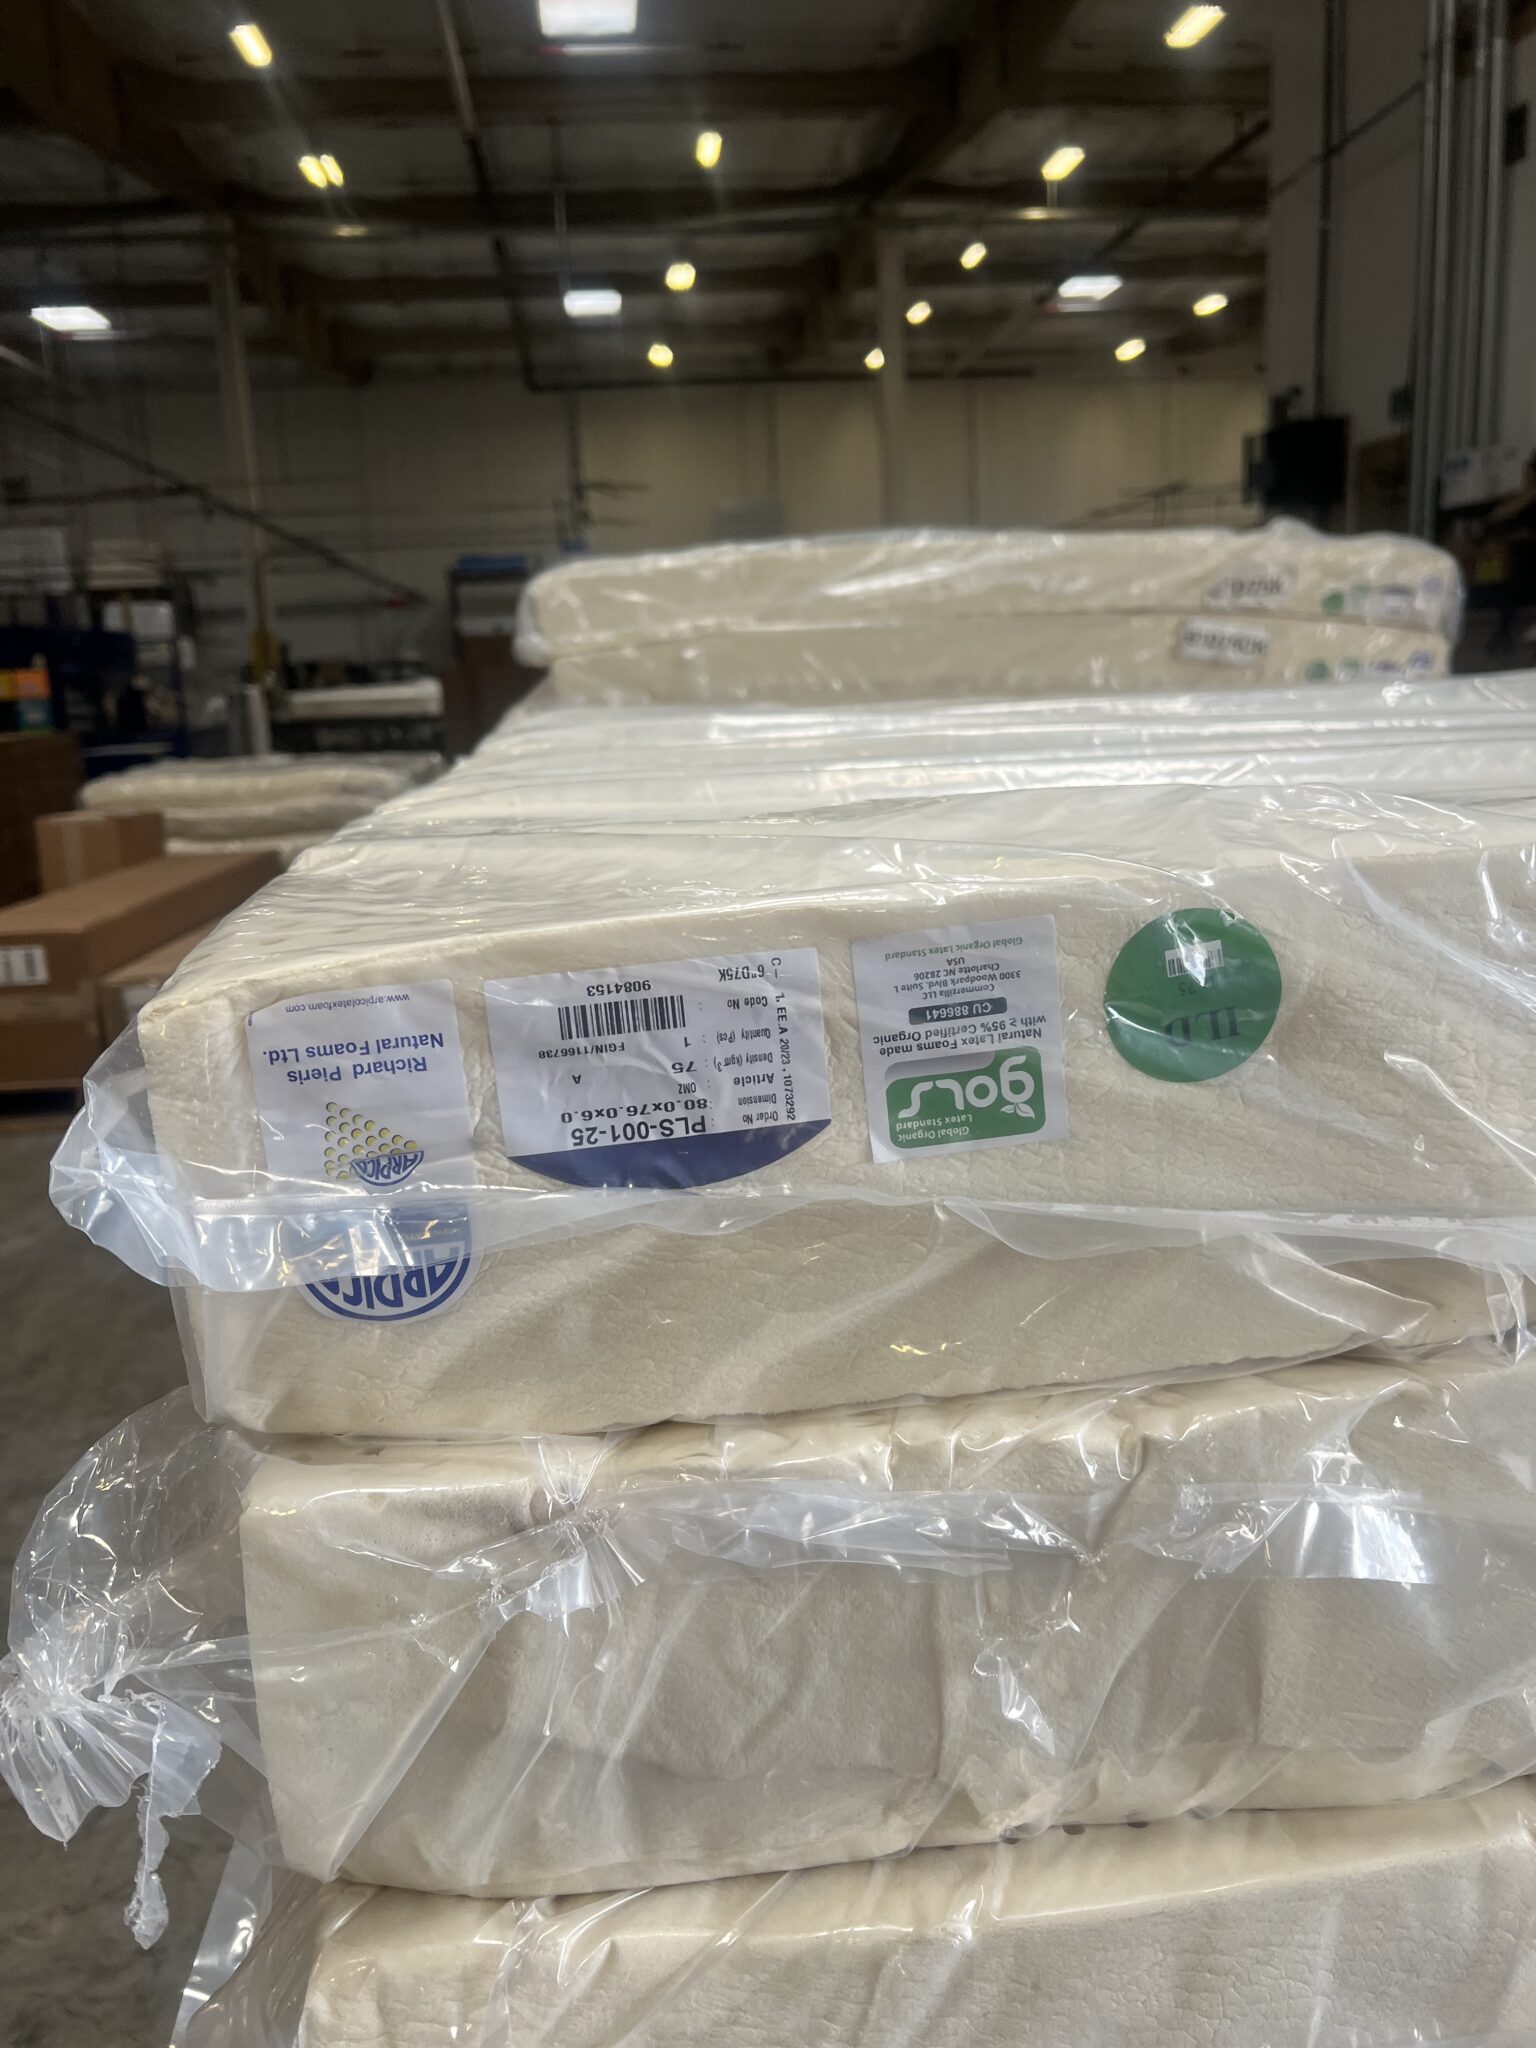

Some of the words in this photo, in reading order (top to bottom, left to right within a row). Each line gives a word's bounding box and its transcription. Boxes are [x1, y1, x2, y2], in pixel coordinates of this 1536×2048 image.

[956, 939, 990, 951] Organic
[992, 936, 1023, 947] Global
[885, 948, 926, 961] Standard
[929, 945, 953, 955] Latex
[946, 957, 965, 966] USA
[958, 962, 1000, 974] Charlotte
[718, 965, 764, 981] 6"D75K
[914, 970, 941, 981] 28206
[942, 968, 956, 976] NC
[950, 971, 997, 986] Woodpark
[999, 970, 1021, 981] 3300
[586, 980, 652, 995] 9084153
[894, 985, 898, 993] L
[901, 982, 923, 992] Suite
[926, 979, 948, 989] Blvd.
[939, 984, 994, 997] Commerzilla
[1178, 982, 1196, 996] 75
[745, 996, 768, 1008] Code
[922, 991, 936, 1000] LLC
[285, 993, 410, 1014] www.arpicolatexfoam.com
[728, 999, 739, 1009] No
[971, 1002, 991, 1014] CU
[925, 1005, 968, 1020] 886641
[981, 1021, 1006, 1032] 95%
[1021, 1016, 1046, 1027] with
[1165, 1007, 1241, 1047] ILD
[717, 1030, 735, 1043] (Pcs)
[741, 1027, 770, 1040] Quantity
[873, 1030, 921, 1045] Organic
[925, 1024, 977, 1039] Certified
[997, 1028, 1042, 1043] Natural
[376, 1032, 443, 1054] Natural
[684, 1037, 691, 1047] 1
[917, 1040, 957, 1051] Foams
[961, 1033, 994, 1046] Latex
[263, 1047, 299, 1065] Ltd.
[305, 1040, 369, 1060] Foams
[538, 1042, 625, 1059] FGIN/1166738
[879, 1044, 913, 1057] made
[746, 1052, 772, 1064] Density
[353, 1057, 427, 1079] Richard
[671, 1061, 697, 1073] 75
[287, 1066, 341, 1085] Pieris
[572, 1074, 582, 1085] A
[734, 1073, 774, 1086] Article
[738, 1094, 776, 1106] Dimension
[560, 1098, 708, 1124] 80.0x76.0x6.0
[757, 1111, 778, 1122] Order
[743, 1114, 753, 1124] No
[896, 1117, 942, 1131] Standard
[944, 1114, 972, 1124] Latex
[571, 1115, 706, 1147] PLS-001-25
[897, 1129, 935, 1142] Organic
[938, 1126, 969, 1136] Global
[353, 1153, 420, 1180] ARPICO
